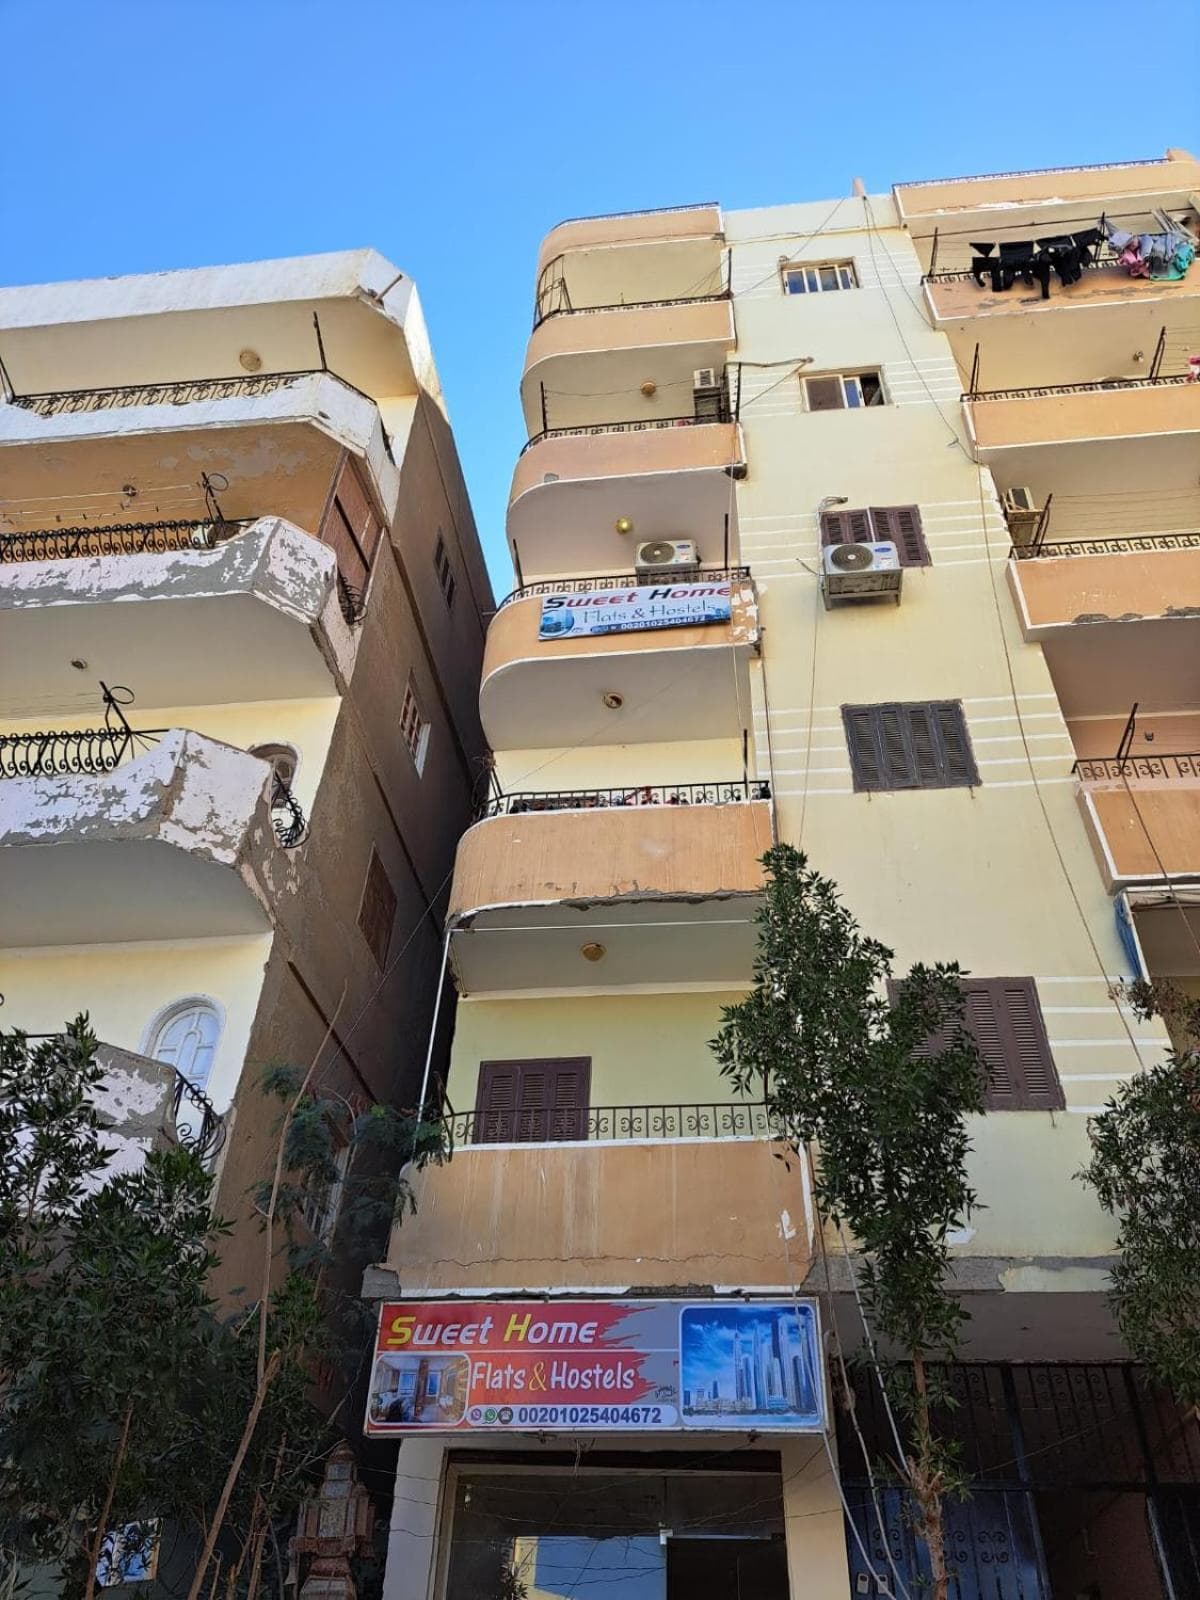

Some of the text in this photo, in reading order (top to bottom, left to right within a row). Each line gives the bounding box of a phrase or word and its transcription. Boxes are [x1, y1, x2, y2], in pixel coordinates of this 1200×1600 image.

[544, 586, 731, 609] Sweet Home
[632, 608, 645, 618] &
[650, 600, 715, 617] Hostels
[386, 1313, 597, 1345] Sweet Home
[472, 1362, 634, 1392] Flats & Hostels
[518, 1406, 662, 1425] 00201025404672
